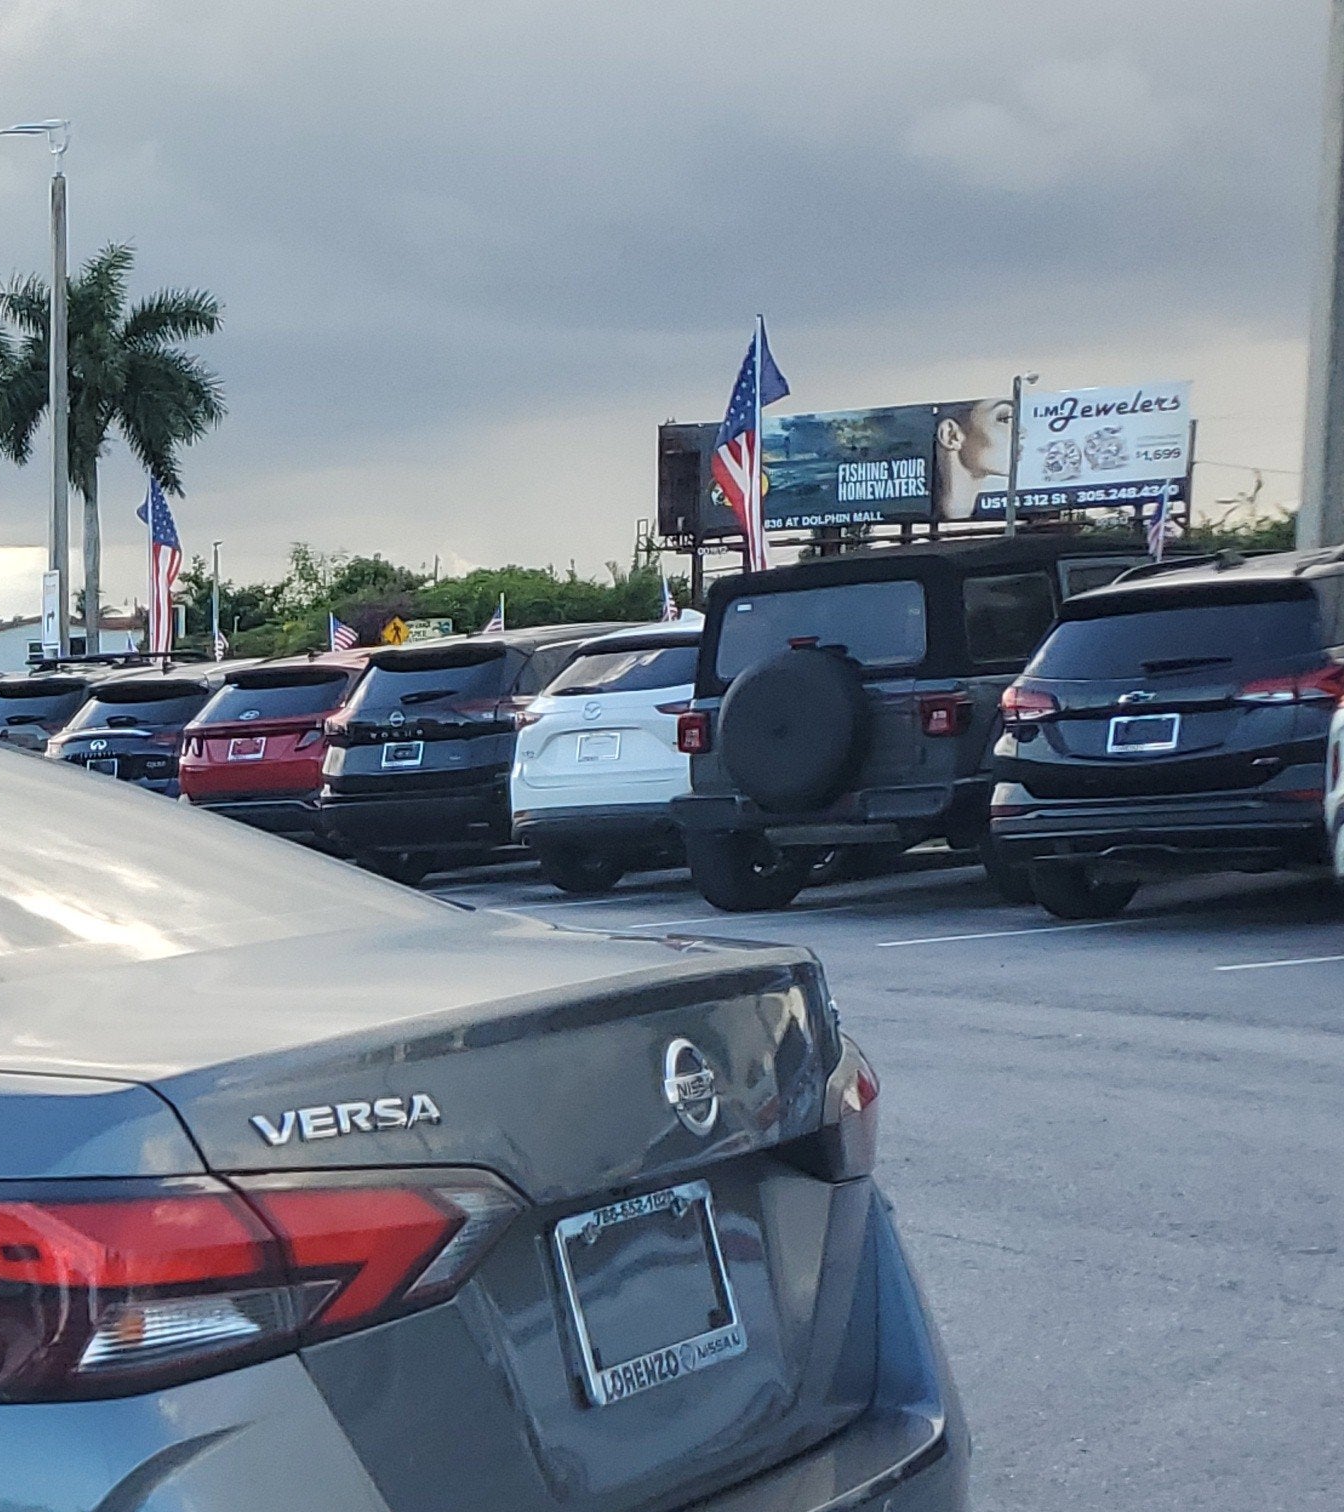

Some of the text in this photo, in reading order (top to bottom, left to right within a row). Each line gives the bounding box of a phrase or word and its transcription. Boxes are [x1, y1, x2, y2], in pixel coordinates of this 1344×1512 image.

[1048, 389, 1182, 432] Jewelers
[838, 458, 926, 482] FISHING YOUR
[838, 477, 929, 502] HOMEWATERS.
[785, 515, 799, 527] AT
[802, 512, 850, 526] DOLPHIN
[853, 511, 883, 522] MALL
[249, 1091, 441, 1147] VERSA
[601, 1332, 740, 1401] LORENZO NISSAN
